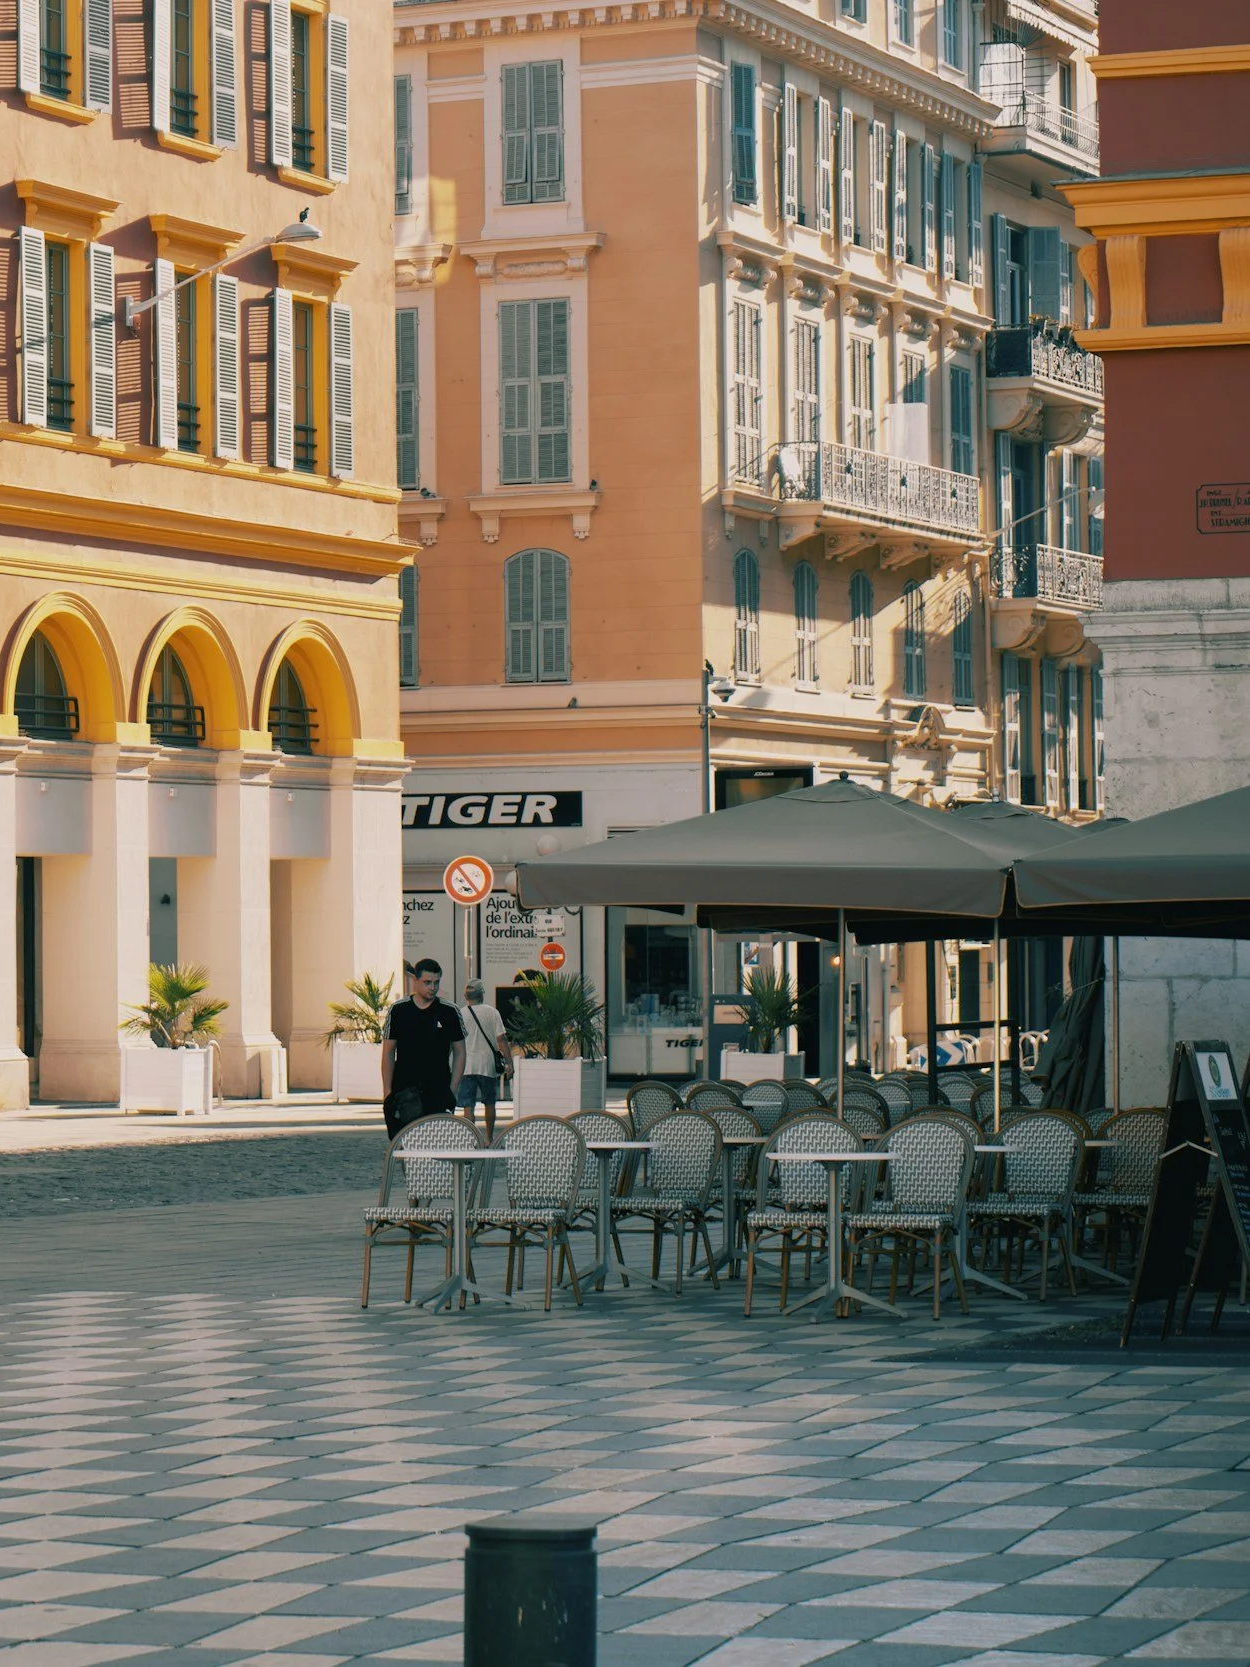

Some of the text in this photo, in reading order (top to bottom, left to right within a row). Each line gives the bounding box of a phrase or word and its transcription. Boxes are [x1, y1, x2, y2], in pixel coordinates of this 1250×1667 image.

[401, 794, 558, 825] TIGER
[486, 912, 502, 924] de
[486, 925, 535, 938] l'ordinai
